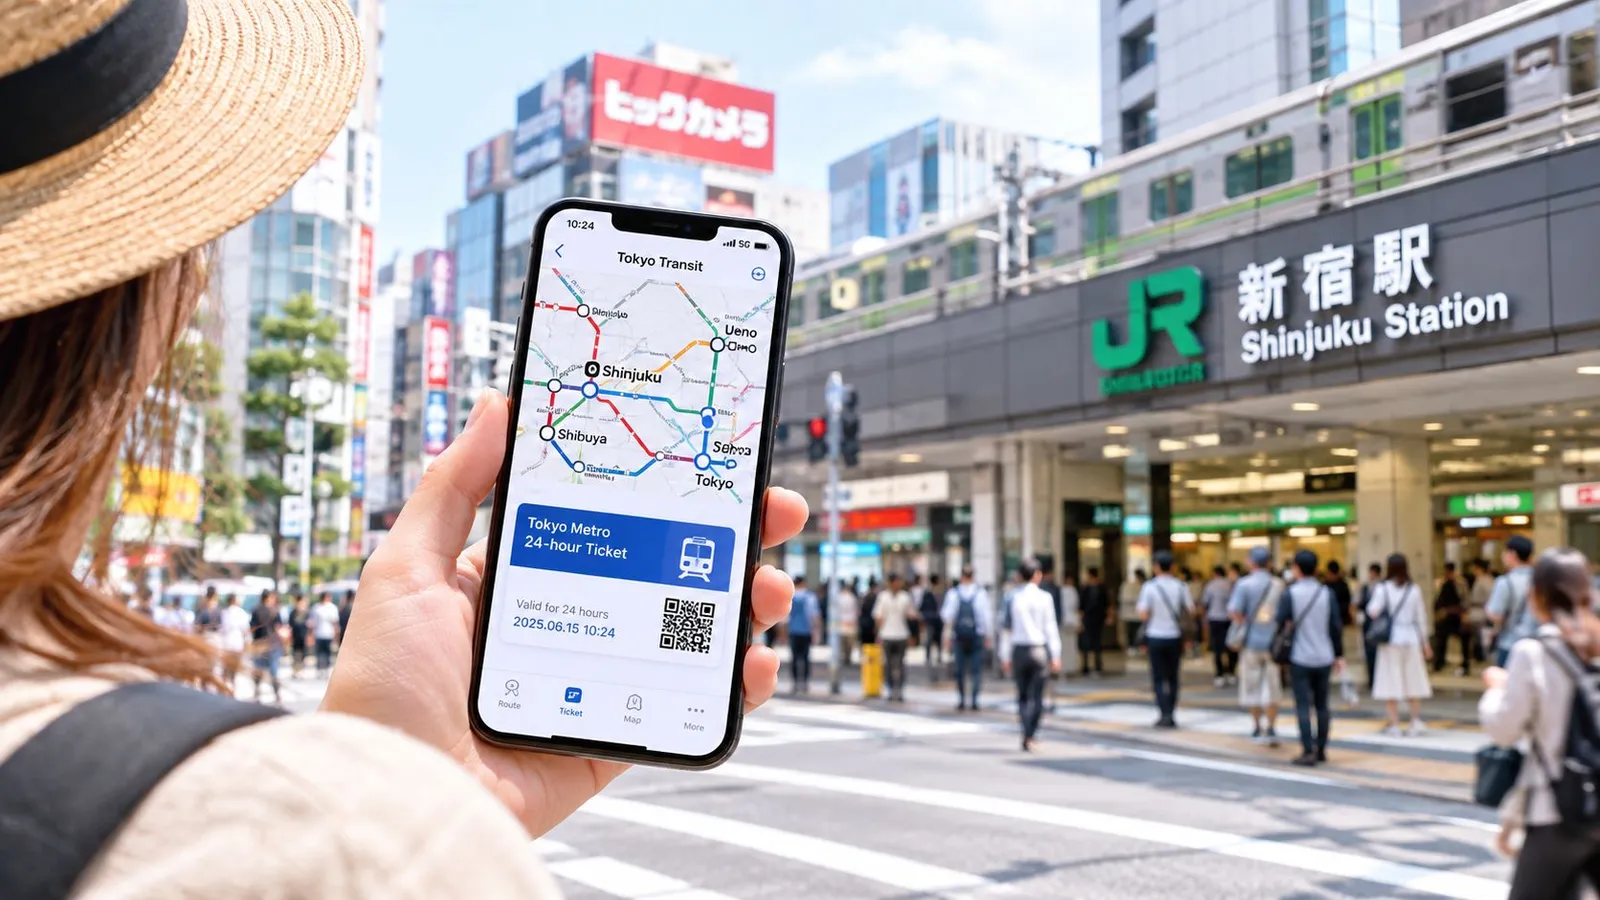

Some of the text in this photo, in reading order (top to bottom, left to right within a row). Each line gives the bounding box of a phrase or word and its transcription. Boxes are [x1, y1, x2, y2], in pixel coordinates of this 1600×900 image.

[566, 219, 595, 231] 10:24
[616, 251, 704, 272] Tokyo Transit
[1237, 222, 1434, 326] 新宿駅
[1092, 265, 1206, 371] JR
[1240, 290, 1509, 364] Shinjuku Station
[724, 324, 758, 338] Ueno
[602, 365, 663, 384] Shinjuku
[557, 428, 608, 445] Shibuya
[695, 473, 734, 491] Tokyo
[528, 516, 610, 538] Tokyo Metro
[524, 535, 627, 559] 24-hour Ticket
[516, 599, 609, 620] Valid for 24 hours
[513, 616, 615, 638] 2025.06.15 10:24
[498, 700, 522, 710] Route
[559, 707, 584, 718] Ticket
[623, 715, 642, 726] Map
[683, 722, 705, 732] More
